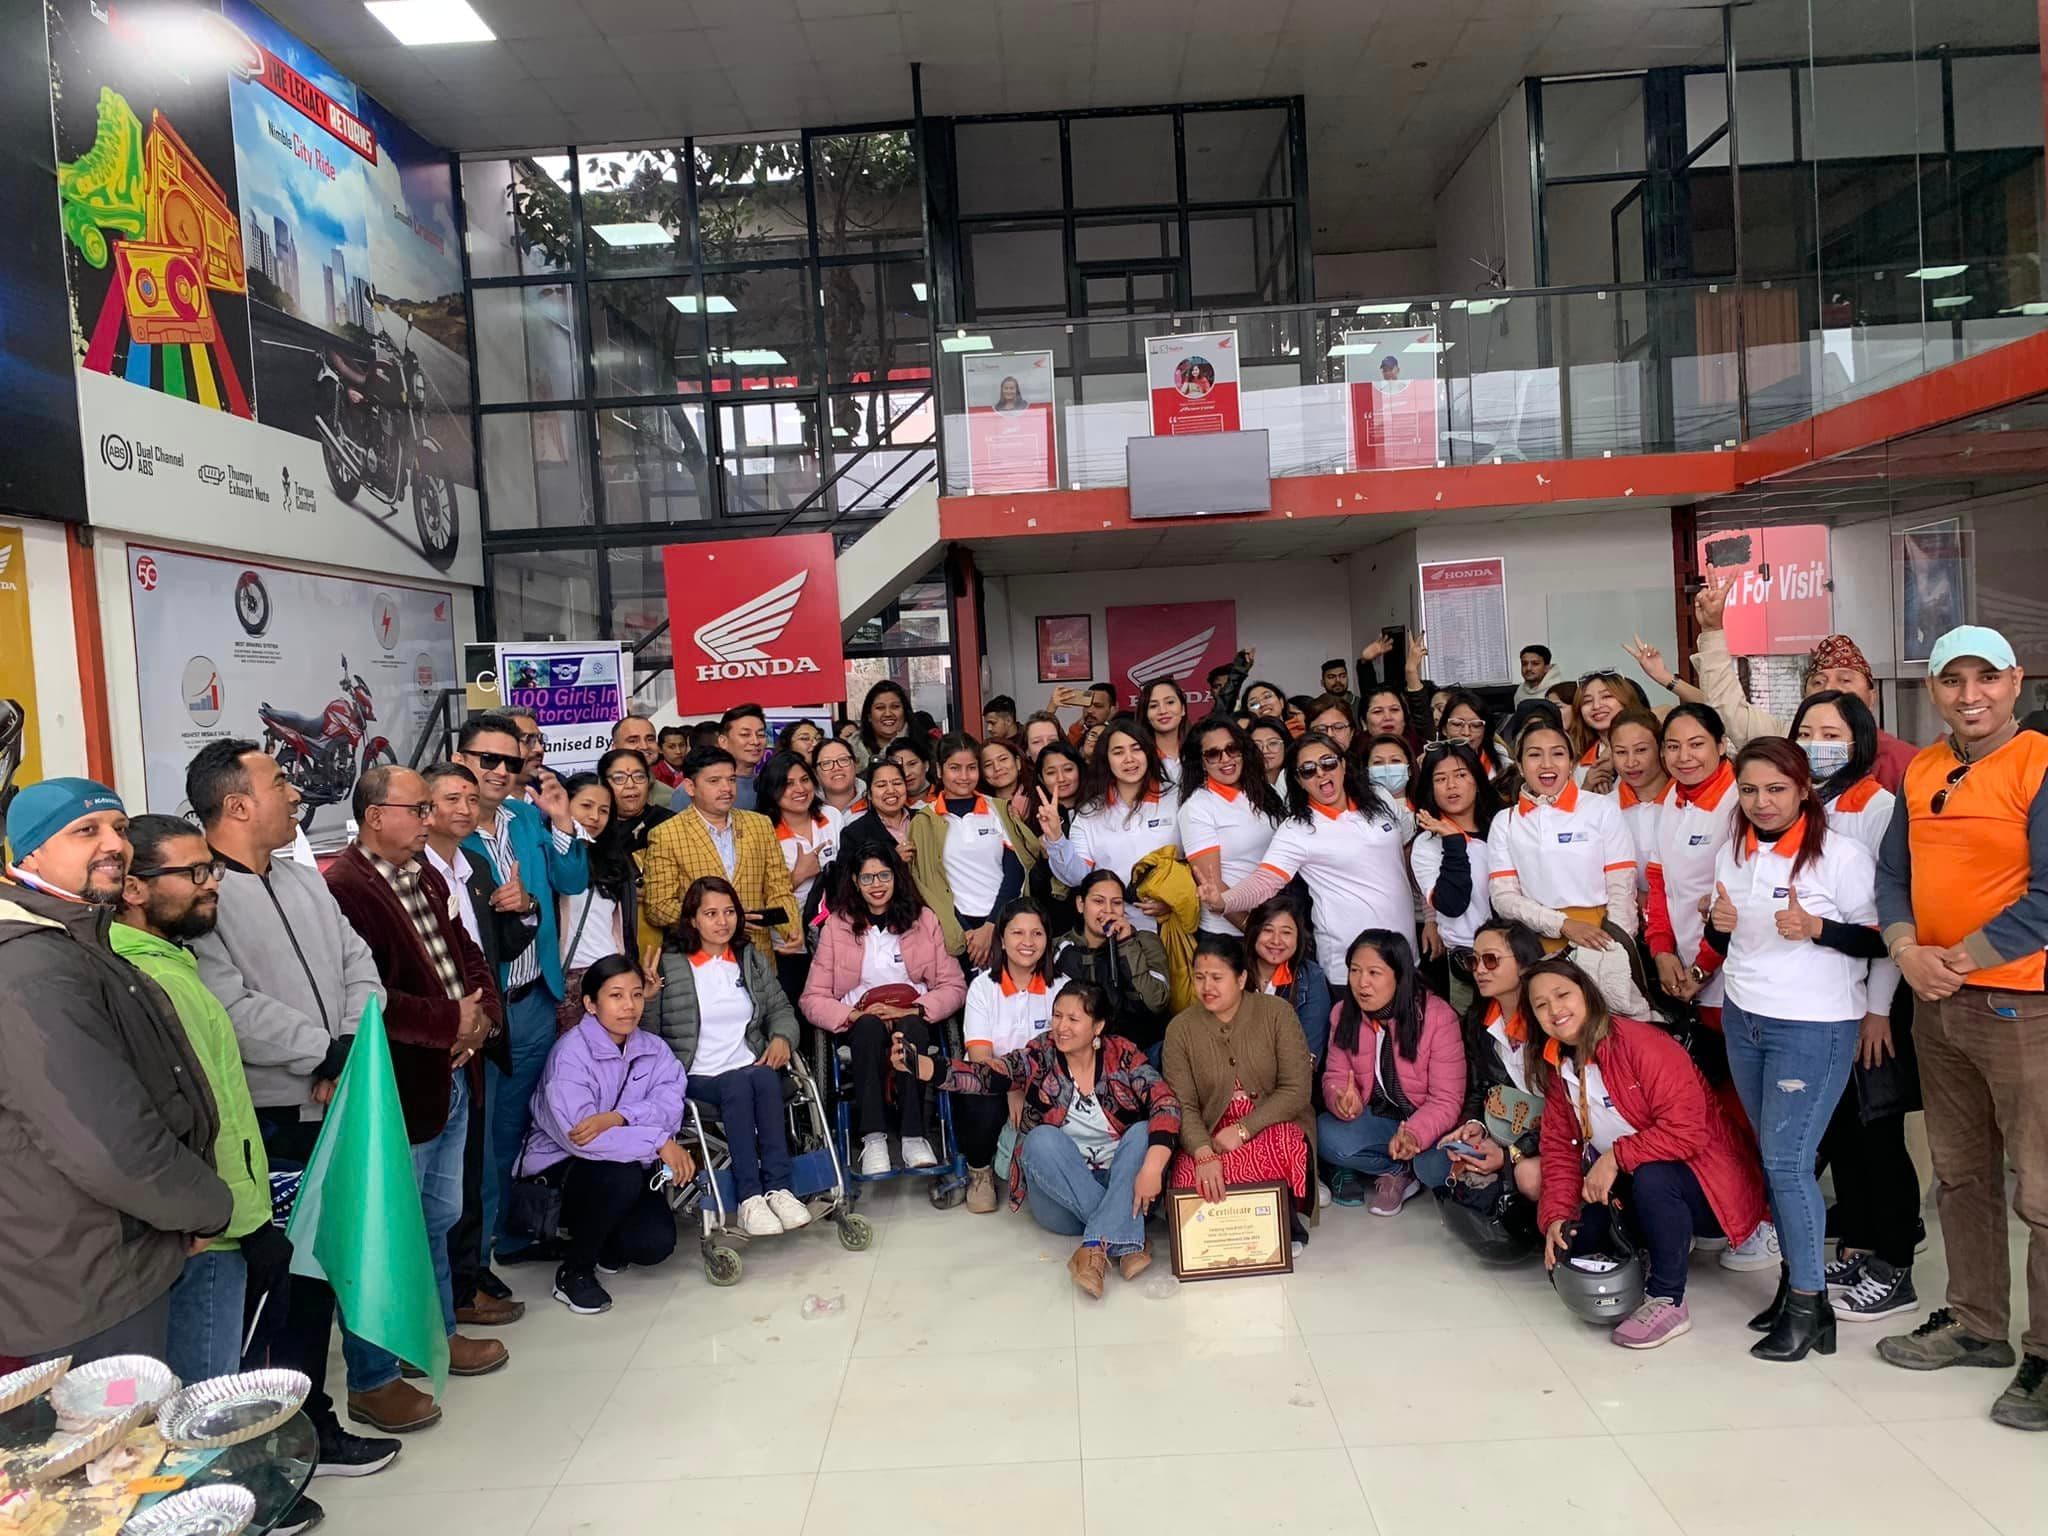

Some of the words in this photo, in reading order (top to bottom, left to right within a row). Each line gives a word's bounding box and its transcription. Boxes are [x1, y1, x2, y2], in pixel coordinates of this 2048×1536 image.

[289, 73, 328, 121] LEGACY
[329, 103, 373, 155] RETURNS
[268, 120, 293, 150] Nimble
[292, 133, 313, 169] City
[315, 148, 336, 181] Ride
[109, 445, 126, 460] ABS
[136, 441, 154, 460] Dual
[155, 446, 185, 467] Channel
[138, 459, 154, 476] ABS
[227, 464, 253, 487] Thumpy
[229, 480, 255, 500] Exhaust
[255, 487, 270, 503] Note
[294, 481, 315, 501] Torque
[296, 495, 317, 513] Control
[1445, 568, 1493, 579] HONDA
[1743, 570, 1774, 605] For
[1779, 560, 1825, 601] Visit
[696, 656, 821, 682] HONDA
[512, 689, 549, 708] 100
[555, 687, 597, 706] Girls
[601, 686, 618, 703] In
[536, 703, 619, 724] torcycling
[543, 735, 592, 753] anised
[596, 735, 612, 752] By
[1207, 1206, 1252, 1217] Certificate
